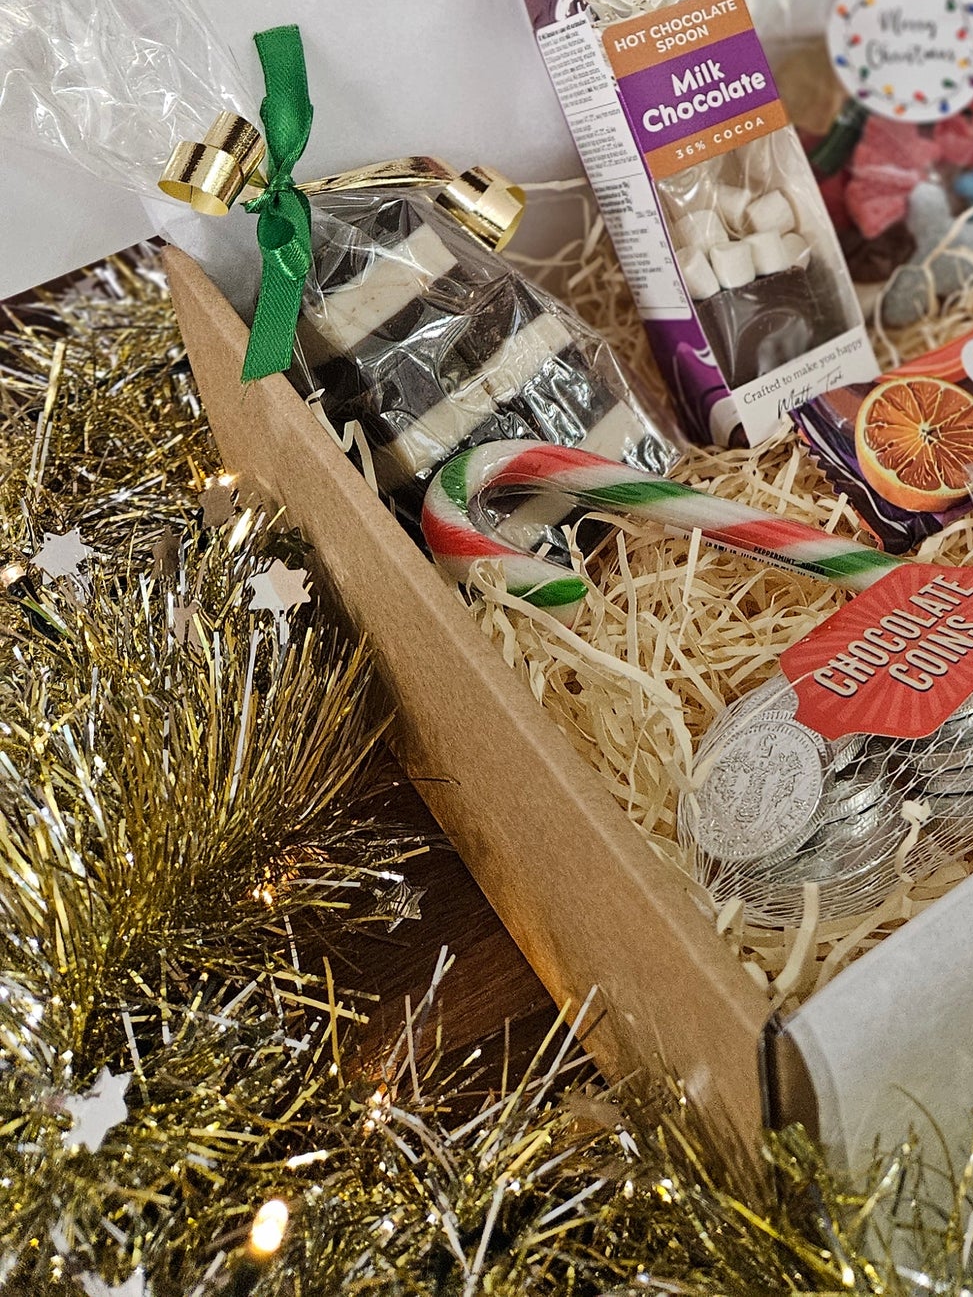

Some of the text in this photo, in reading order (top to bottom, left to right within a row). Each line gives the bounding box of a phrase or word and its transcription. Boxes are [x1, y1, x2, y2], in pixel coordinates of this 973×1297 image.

[614, 31, 647, 52] HOT
[656, 25, 709, 53] SPOON
[671, 59, 726, 97] Milk
[642, 72, 767, 132] Chocolate
[675, 116, 765, 160] 36% COCOA
[743, 339, 863, 405] Crafted to make you happy
[753, 545, 796, 565] PEPPERMINT
